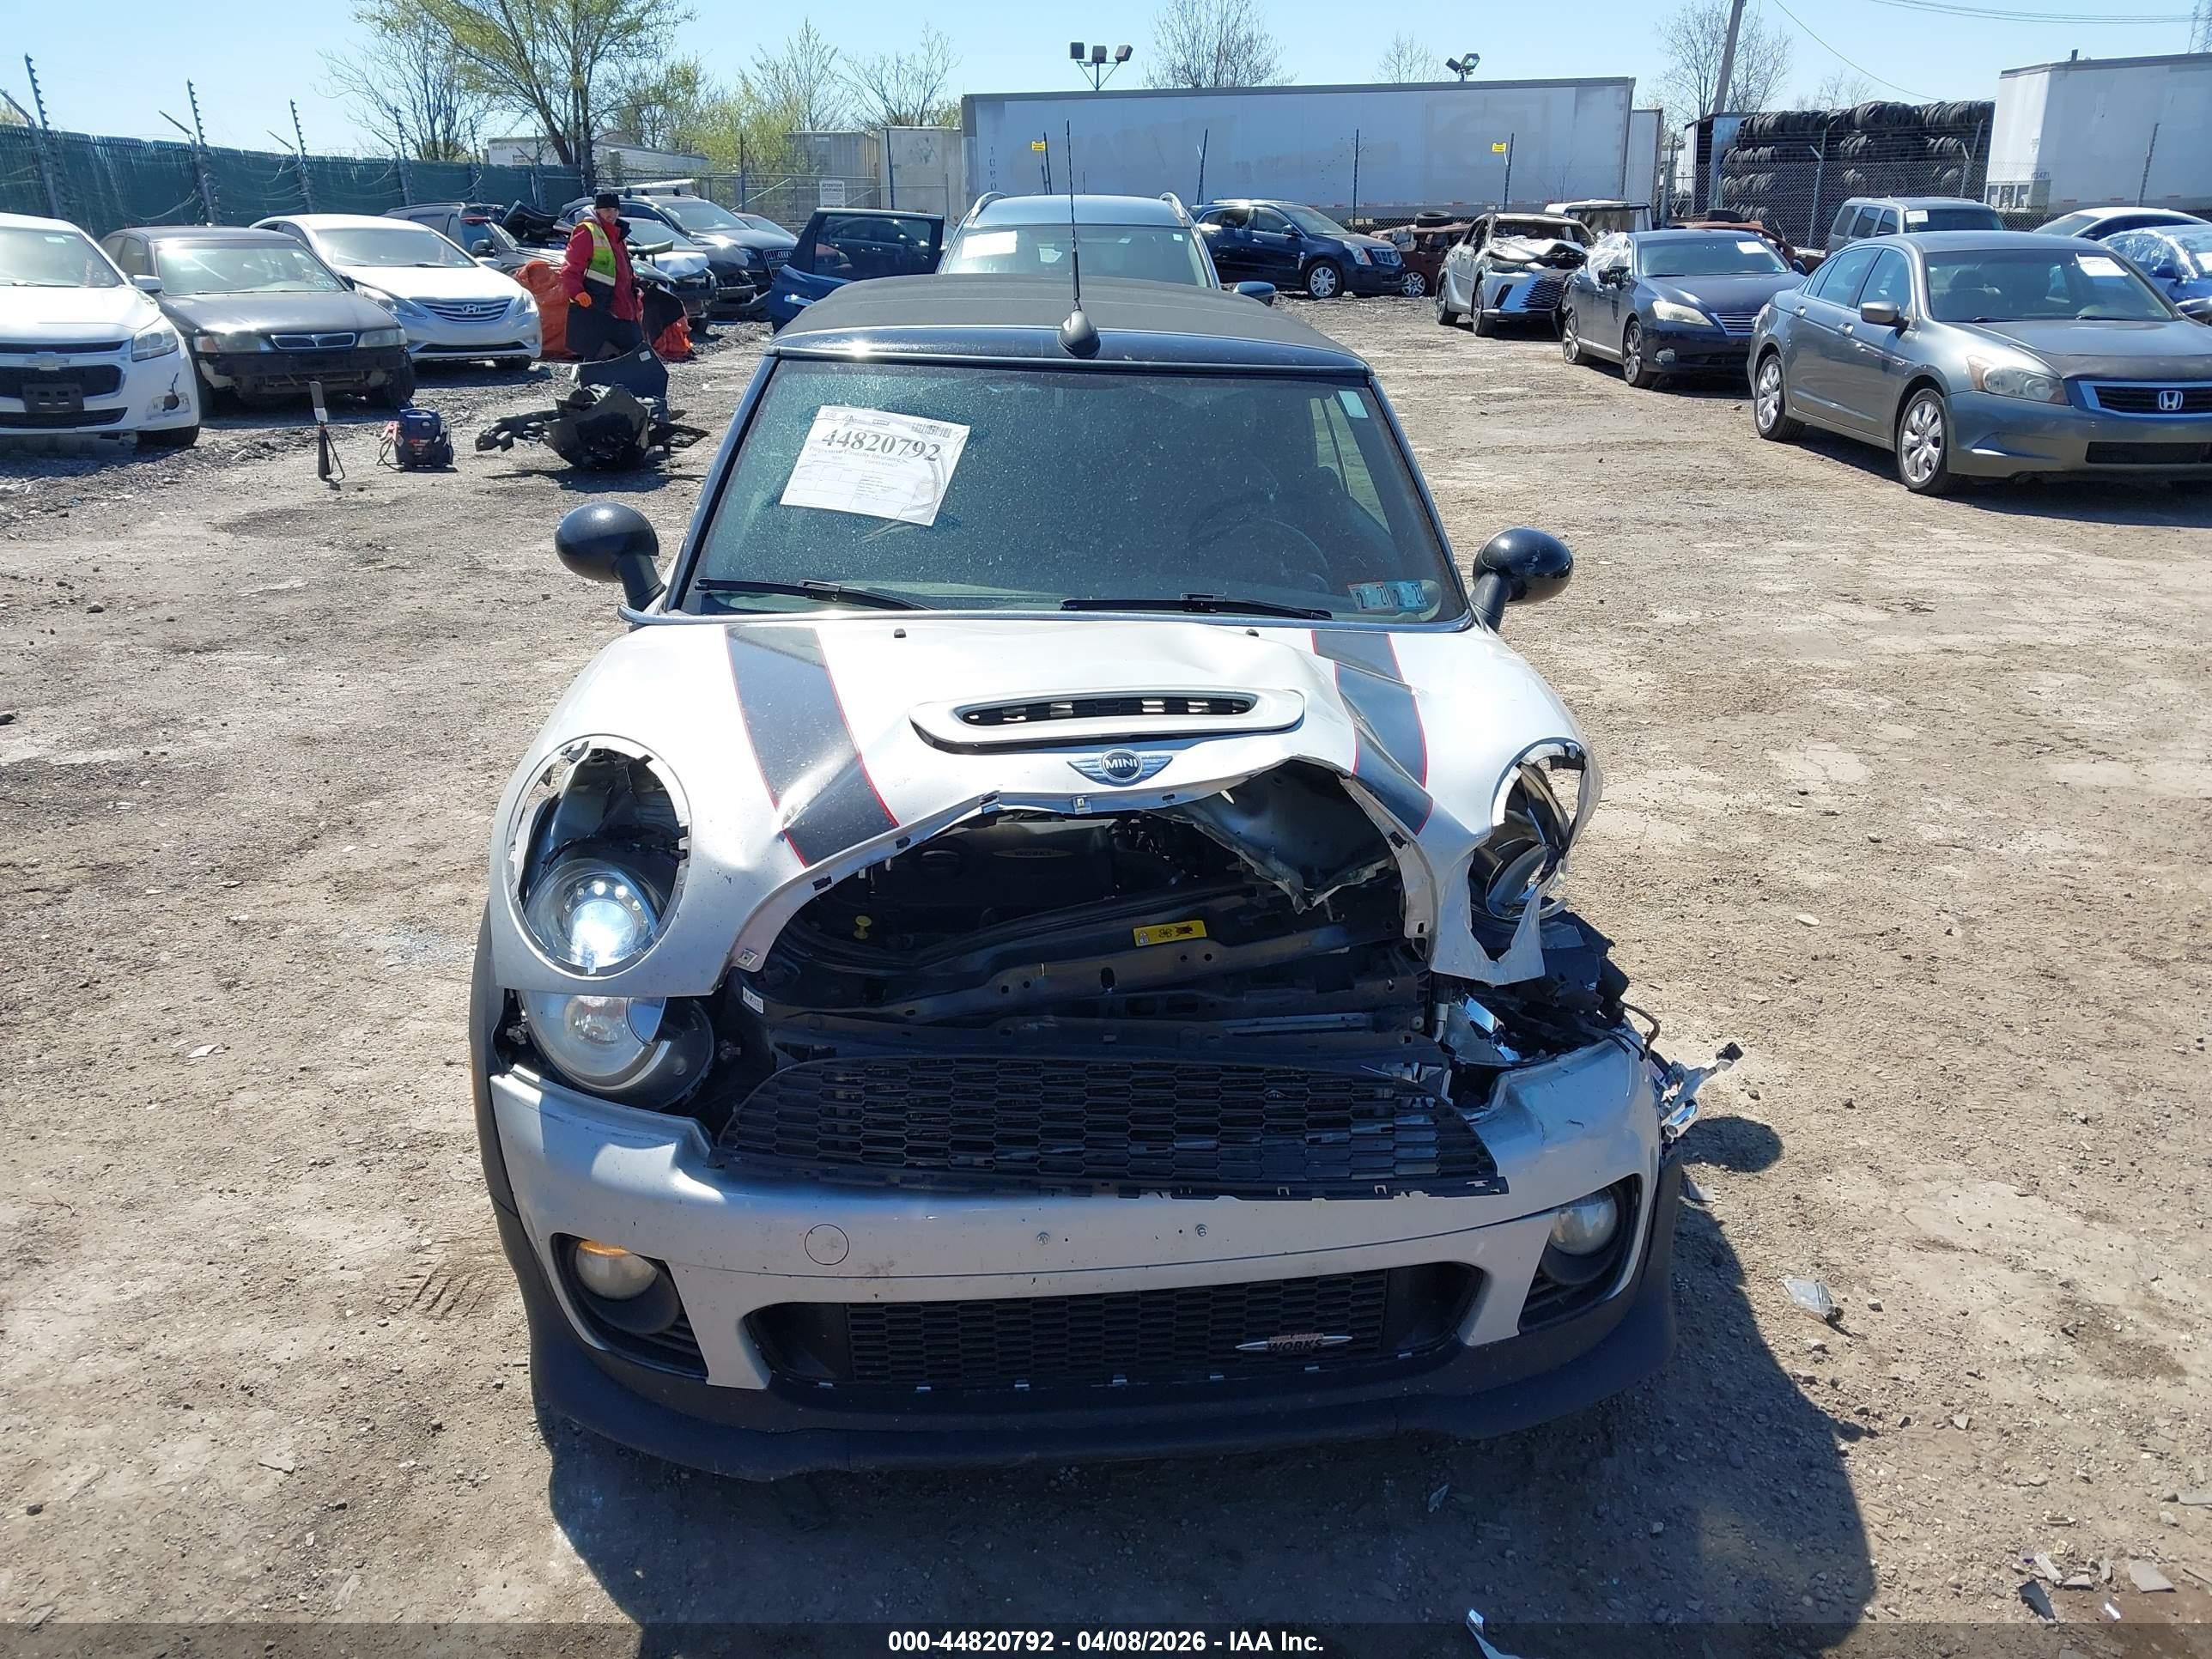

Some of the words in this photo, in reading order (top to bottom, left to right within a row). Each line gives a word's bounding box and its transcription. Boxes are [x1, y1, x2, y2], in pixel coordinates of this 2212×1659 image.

[822, 429, 941, 462] 44820792
[1105, 757, 1139, 769] MINI
[1269, 1340, 1323, 1352] WORKS
